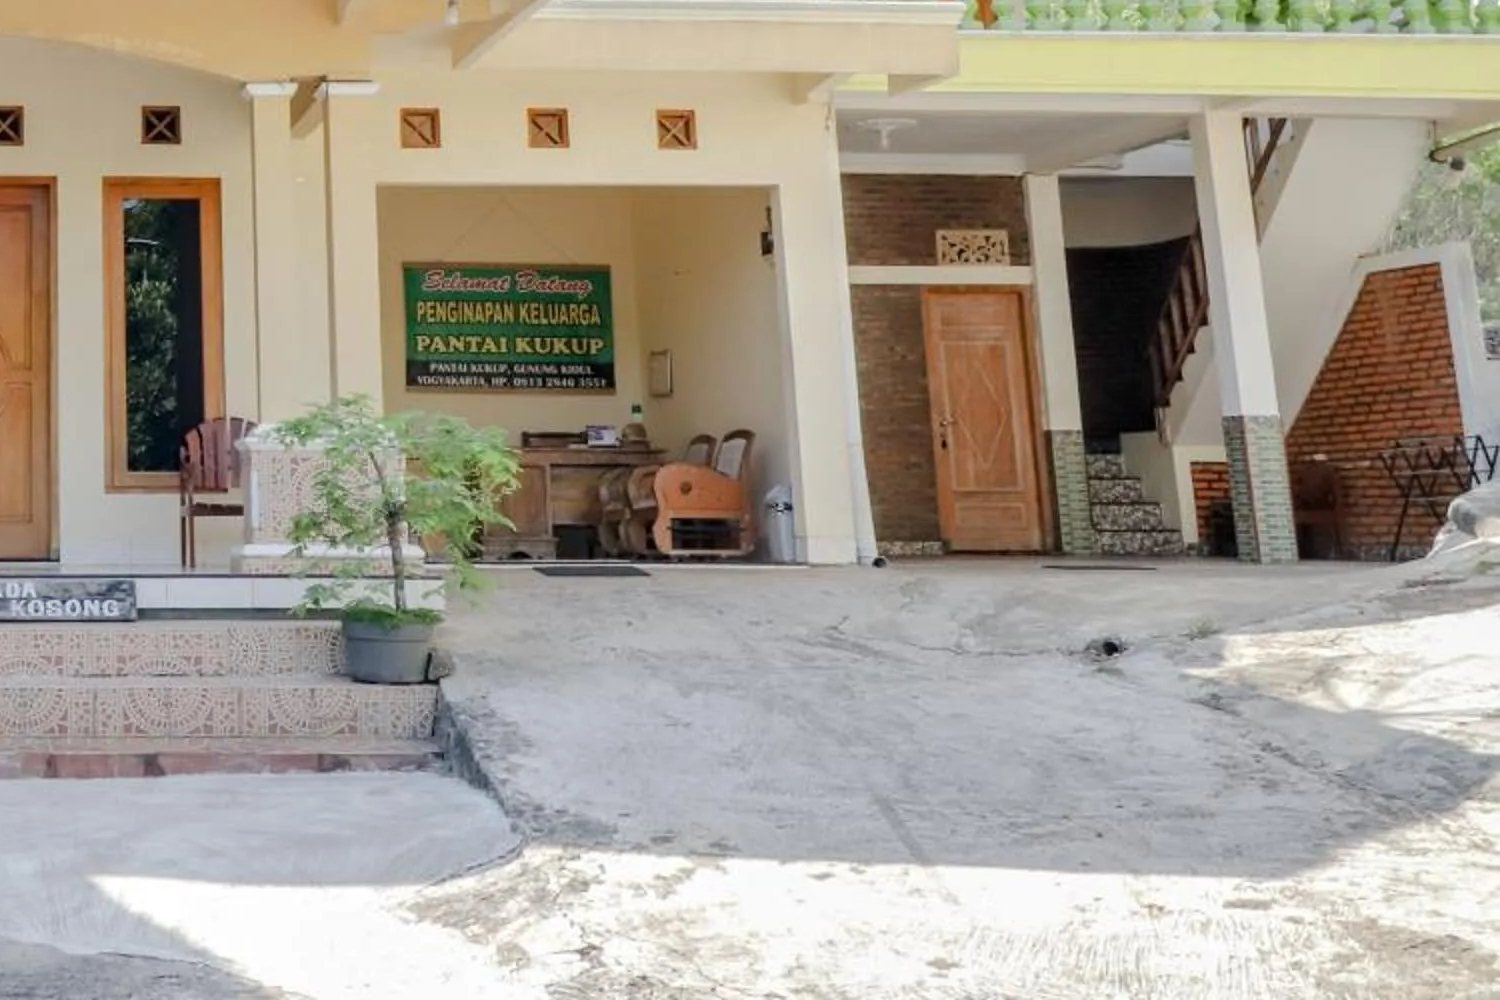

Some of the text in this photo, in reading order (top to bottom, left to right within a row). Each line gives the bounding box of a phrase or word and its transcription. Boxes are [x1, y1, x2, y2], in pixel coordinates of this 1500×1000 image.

[422, 269, 593, 298] Selamat Datang
[417, 301, 600, 326] PENGINAPAN KELUARGA
[416, 335, 604, 355] PANTAI KUKUP
[11, 599, 120, 617] KOSONG
